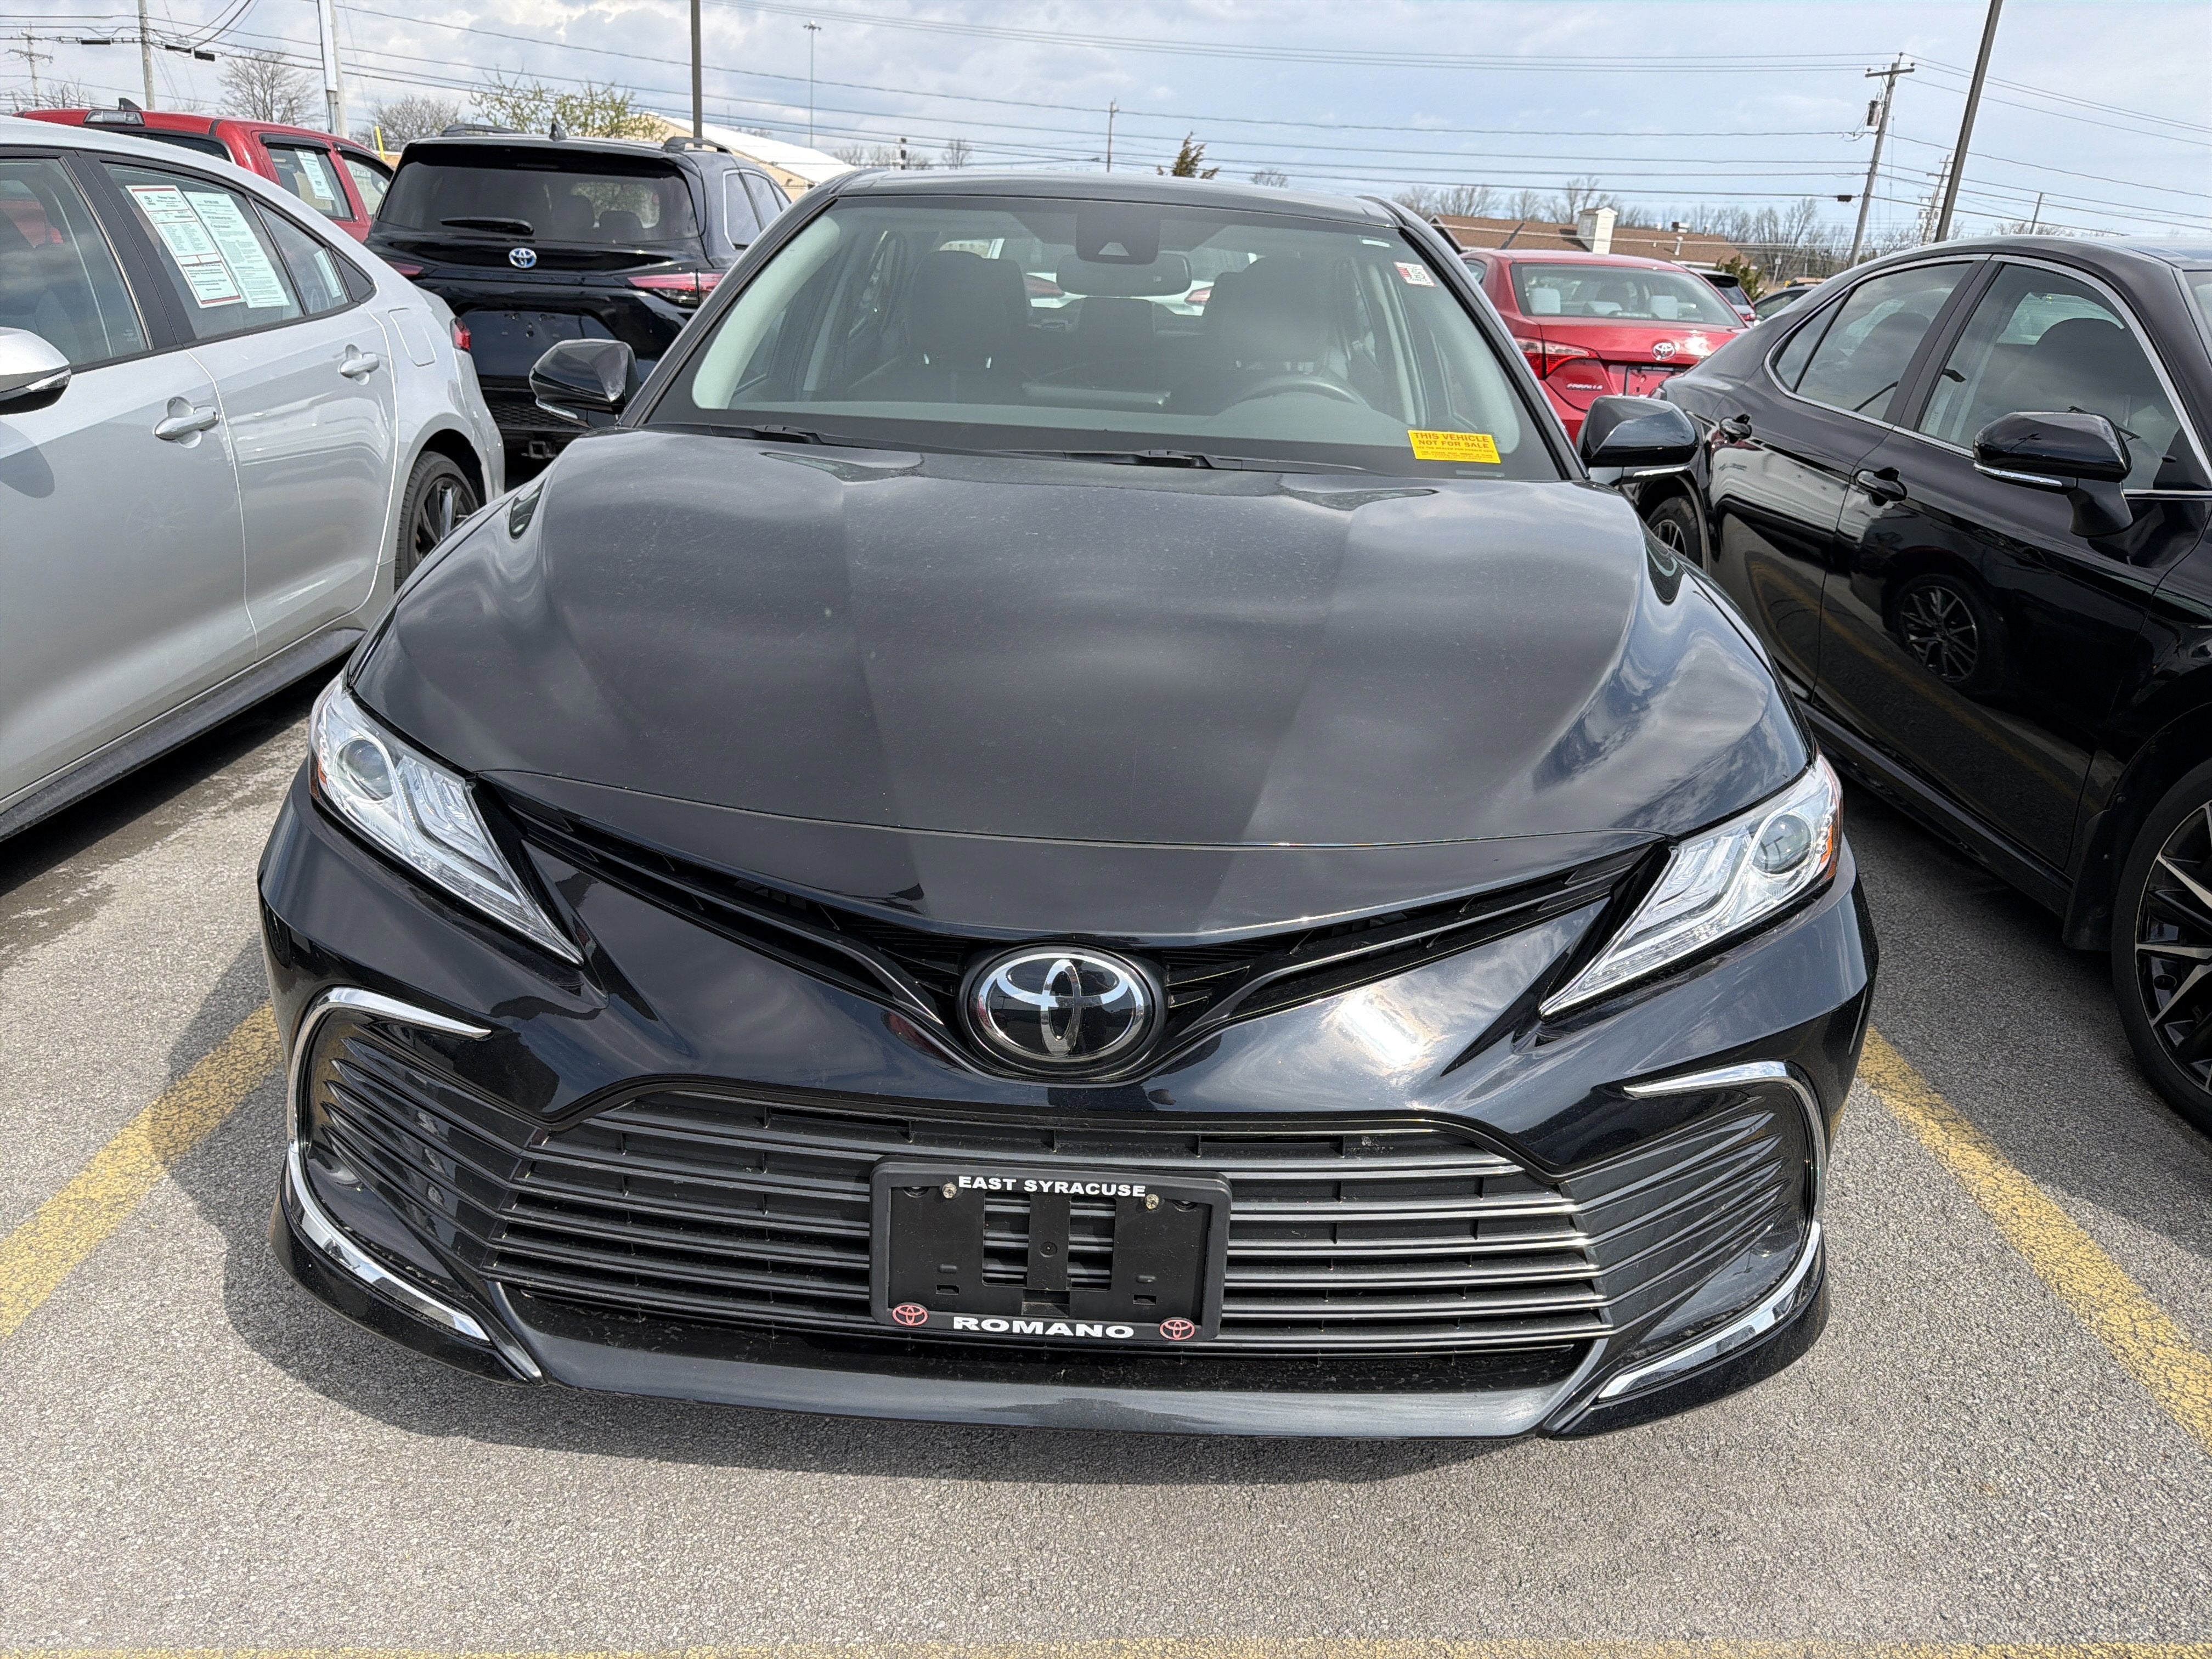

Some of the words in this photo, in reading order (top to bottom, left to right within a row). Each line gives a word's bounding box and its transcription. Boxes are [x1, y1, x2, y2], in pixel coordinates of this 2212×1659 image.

[1442, 433, 1489, 443] VEHICLE
[958, 1176, 1017, 1190] EAST
[1024, 1180, 1146, 1197] SYRACUSE
[953, 1317, 1134, 1339] ROMANO
